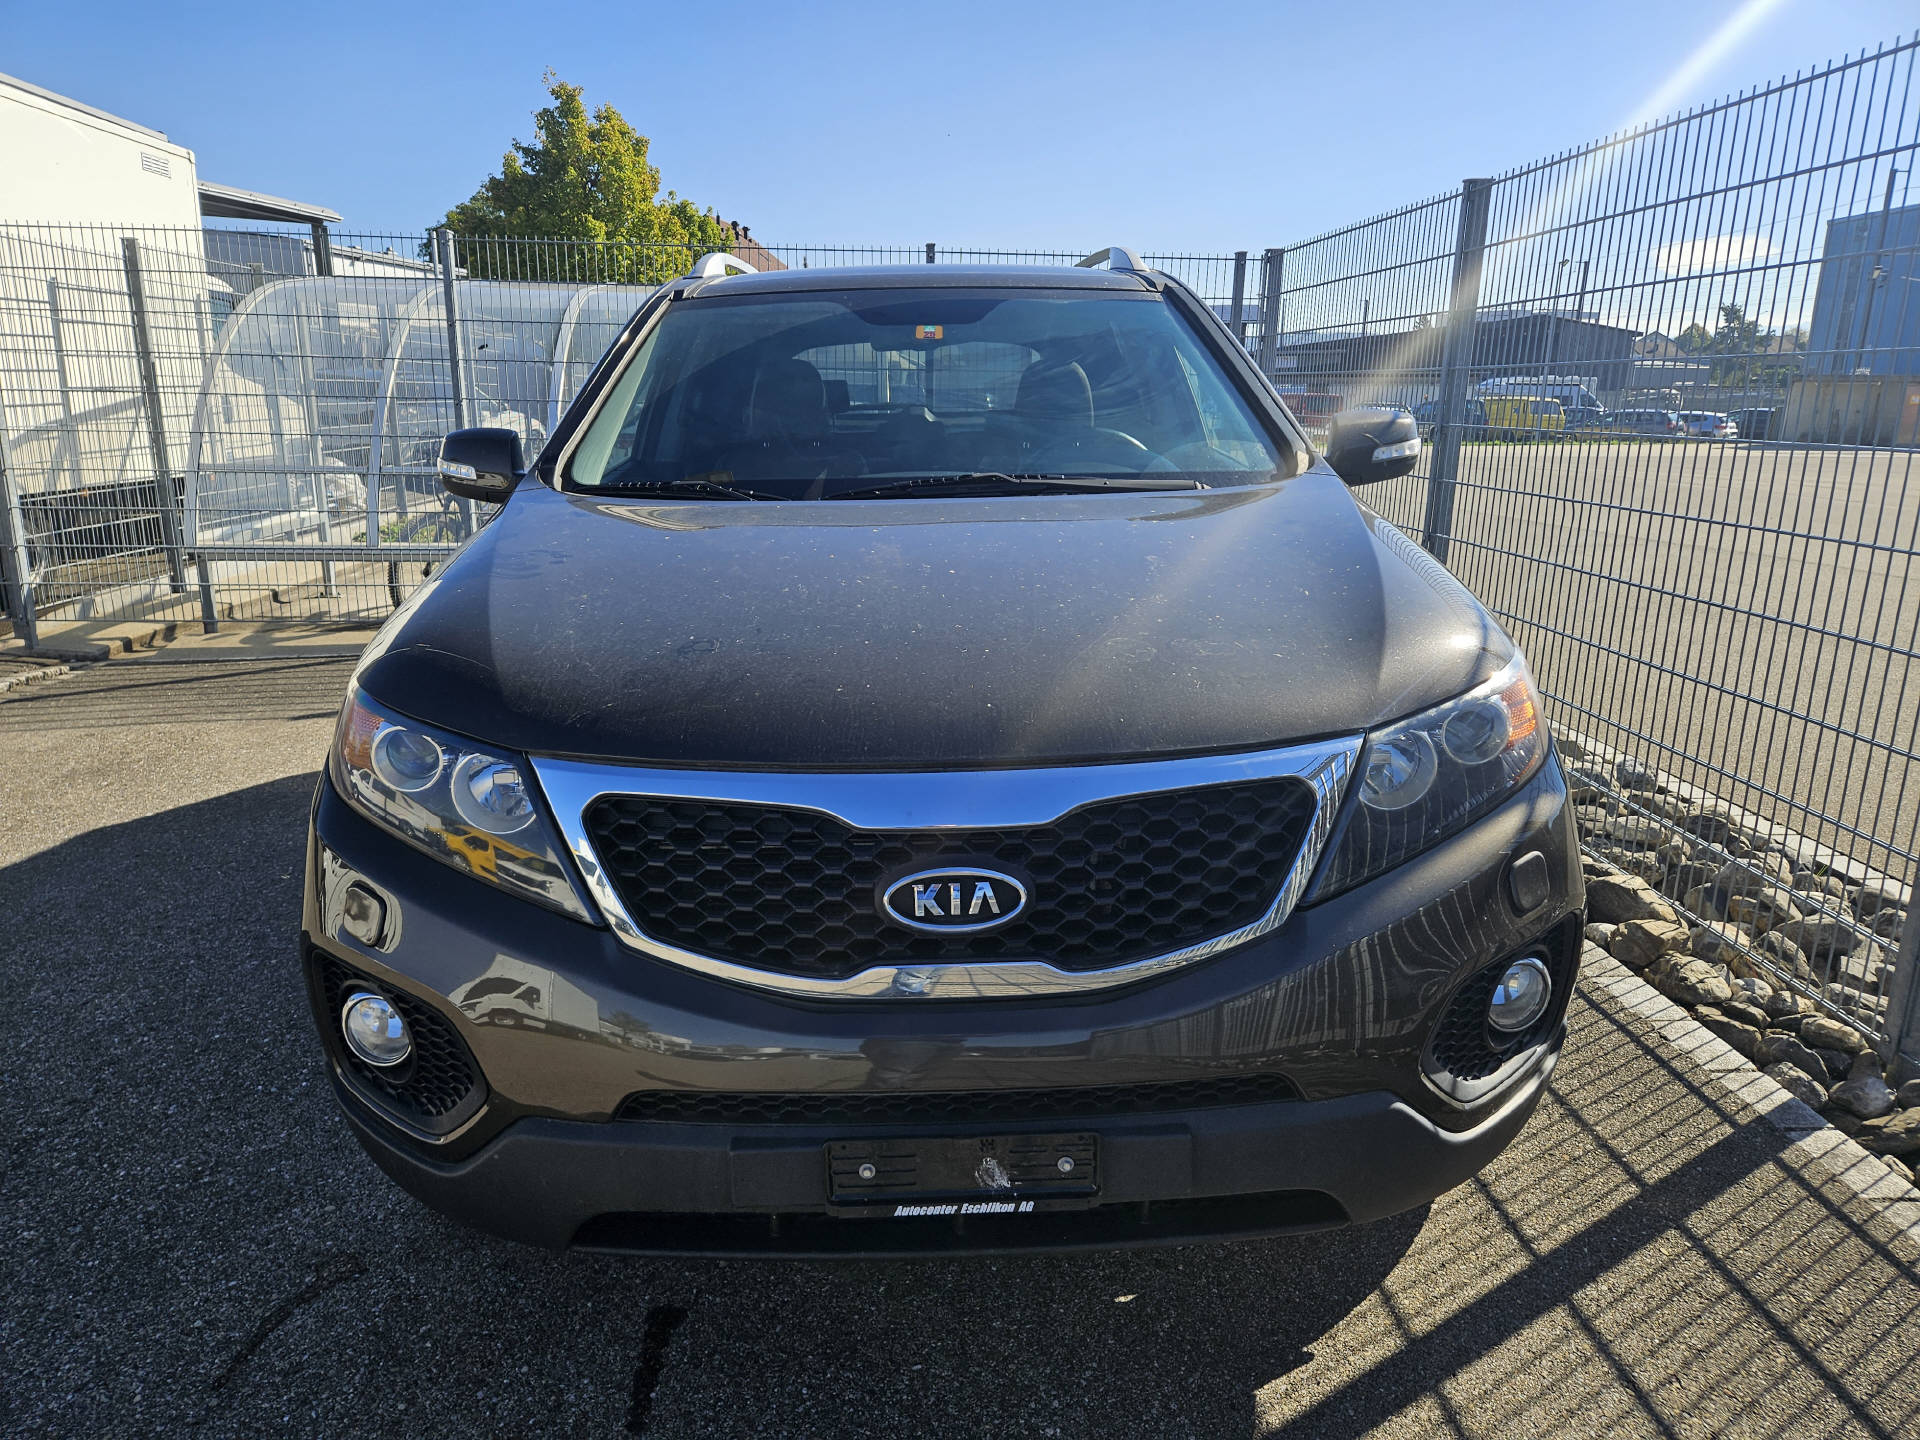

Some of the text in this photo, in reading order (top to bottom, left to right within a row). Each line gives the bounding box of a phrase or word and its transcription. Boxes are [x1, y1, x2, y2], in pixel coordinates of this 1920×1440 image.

[911, 881, 1001, 917] KIA
[894, 1201, 1035, 1216] Autocenter Eschlikon AG
